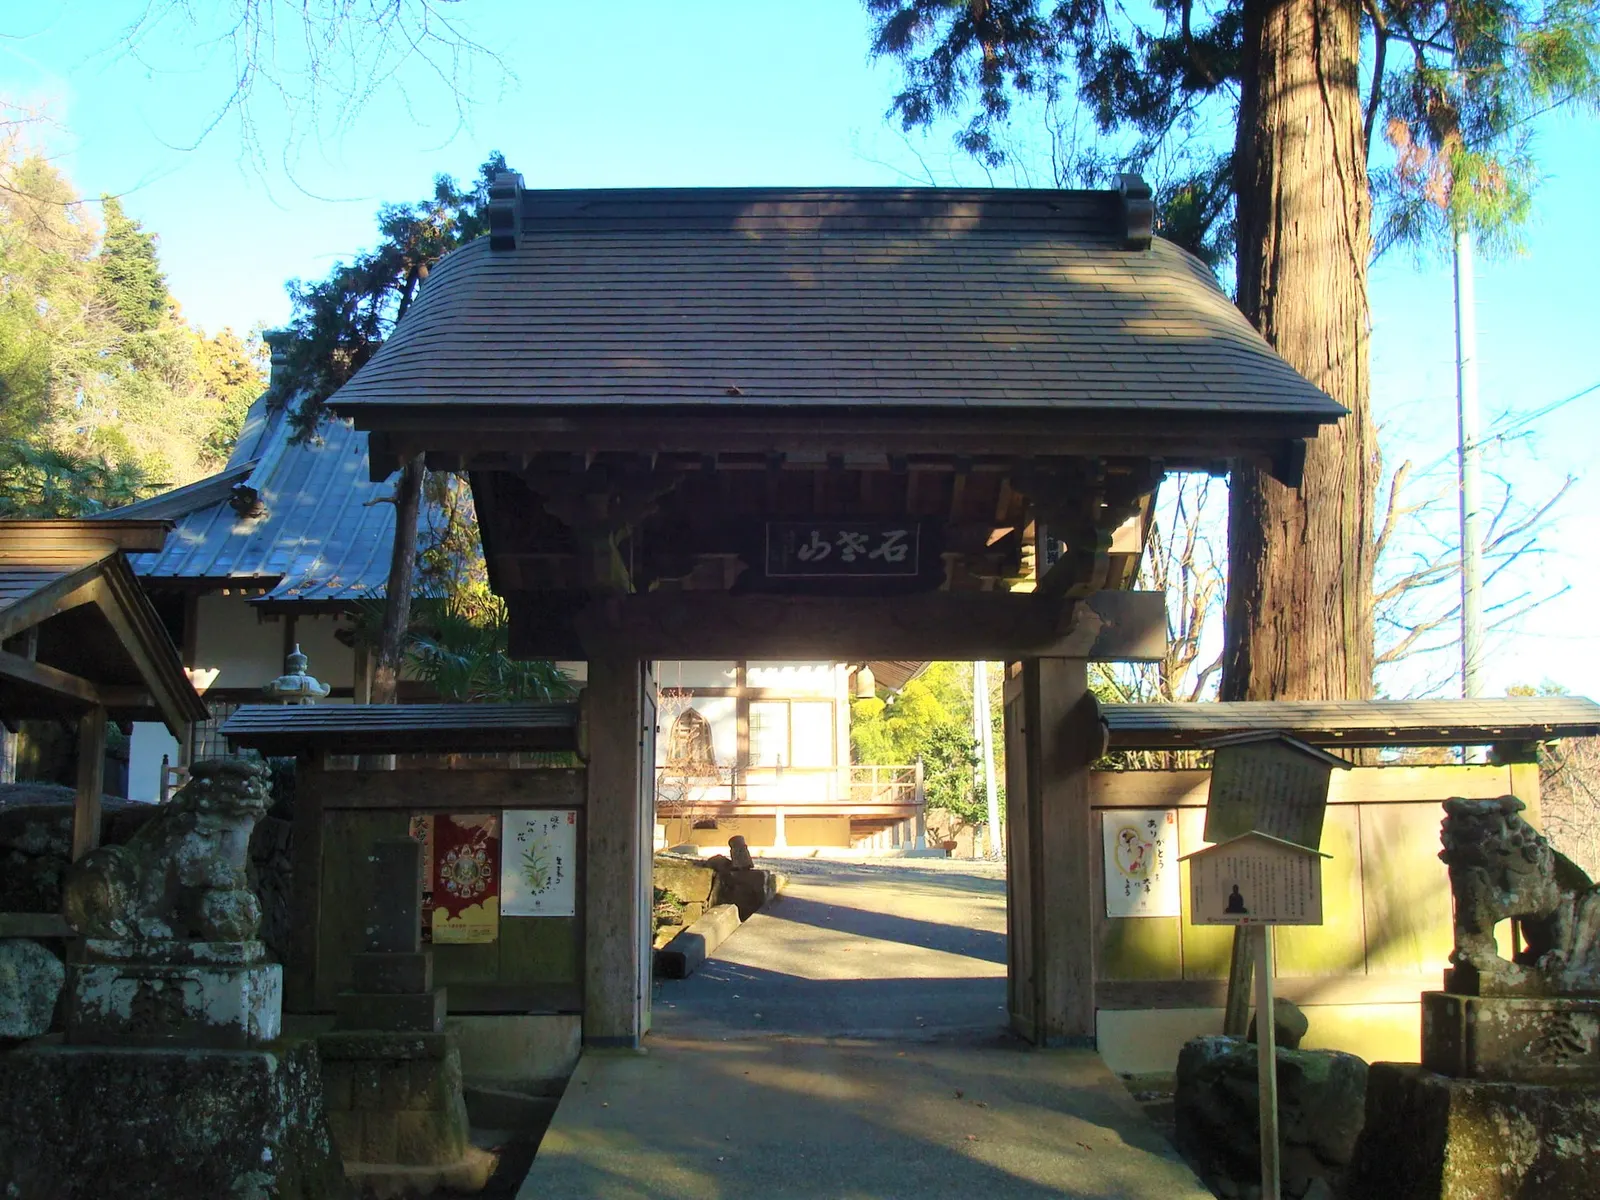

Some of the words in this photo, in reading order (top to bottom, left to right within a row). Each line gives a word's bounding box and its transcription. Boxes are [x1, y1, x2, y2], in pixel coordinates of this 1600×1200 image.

[1147, 818, 1165, 869] ありがとう
